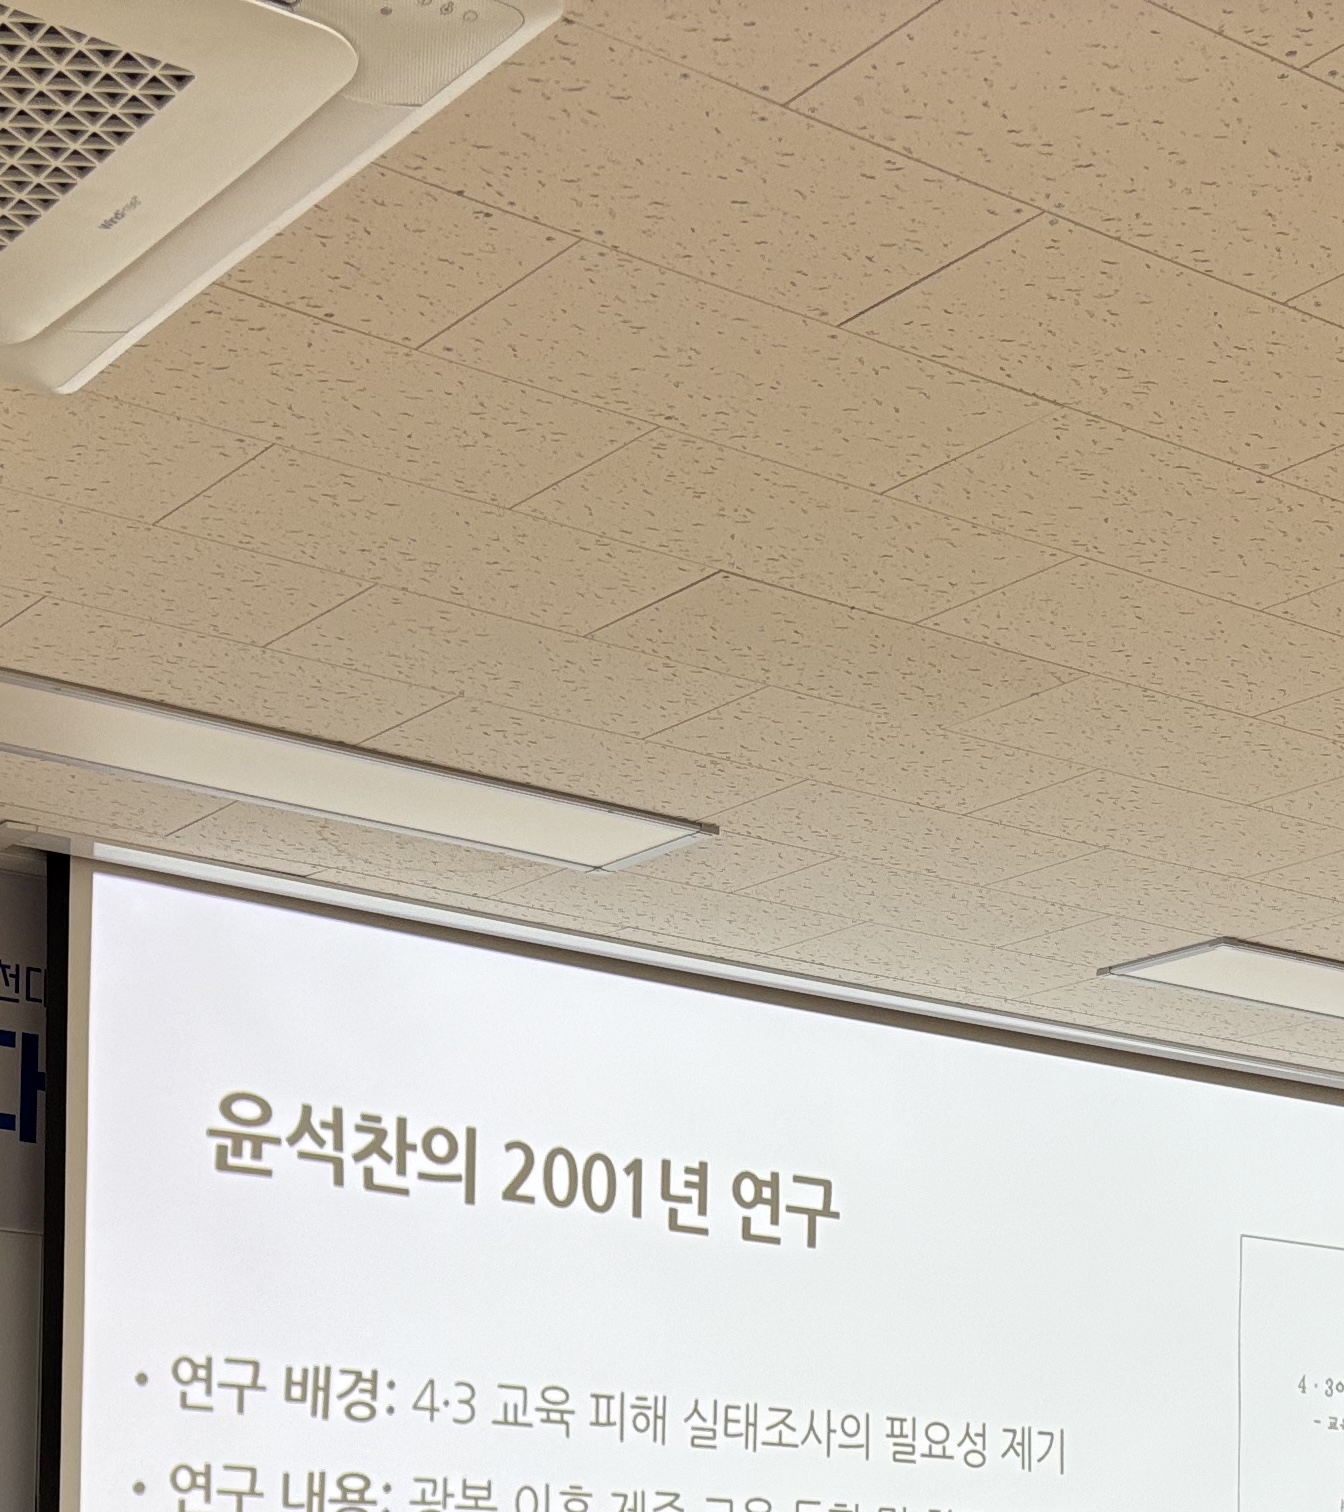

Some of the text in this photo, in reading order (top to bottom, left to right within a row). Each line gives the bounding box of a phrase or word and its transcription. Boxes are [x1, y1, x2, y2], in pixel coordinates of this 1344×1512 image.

[205, 1091, 841, 1249] 윤석찬의 2001년 연구
[171, 1355, 1065, 1476] 연구 배경: 4·3 교육 피해 실태조사의 필요성 제기
